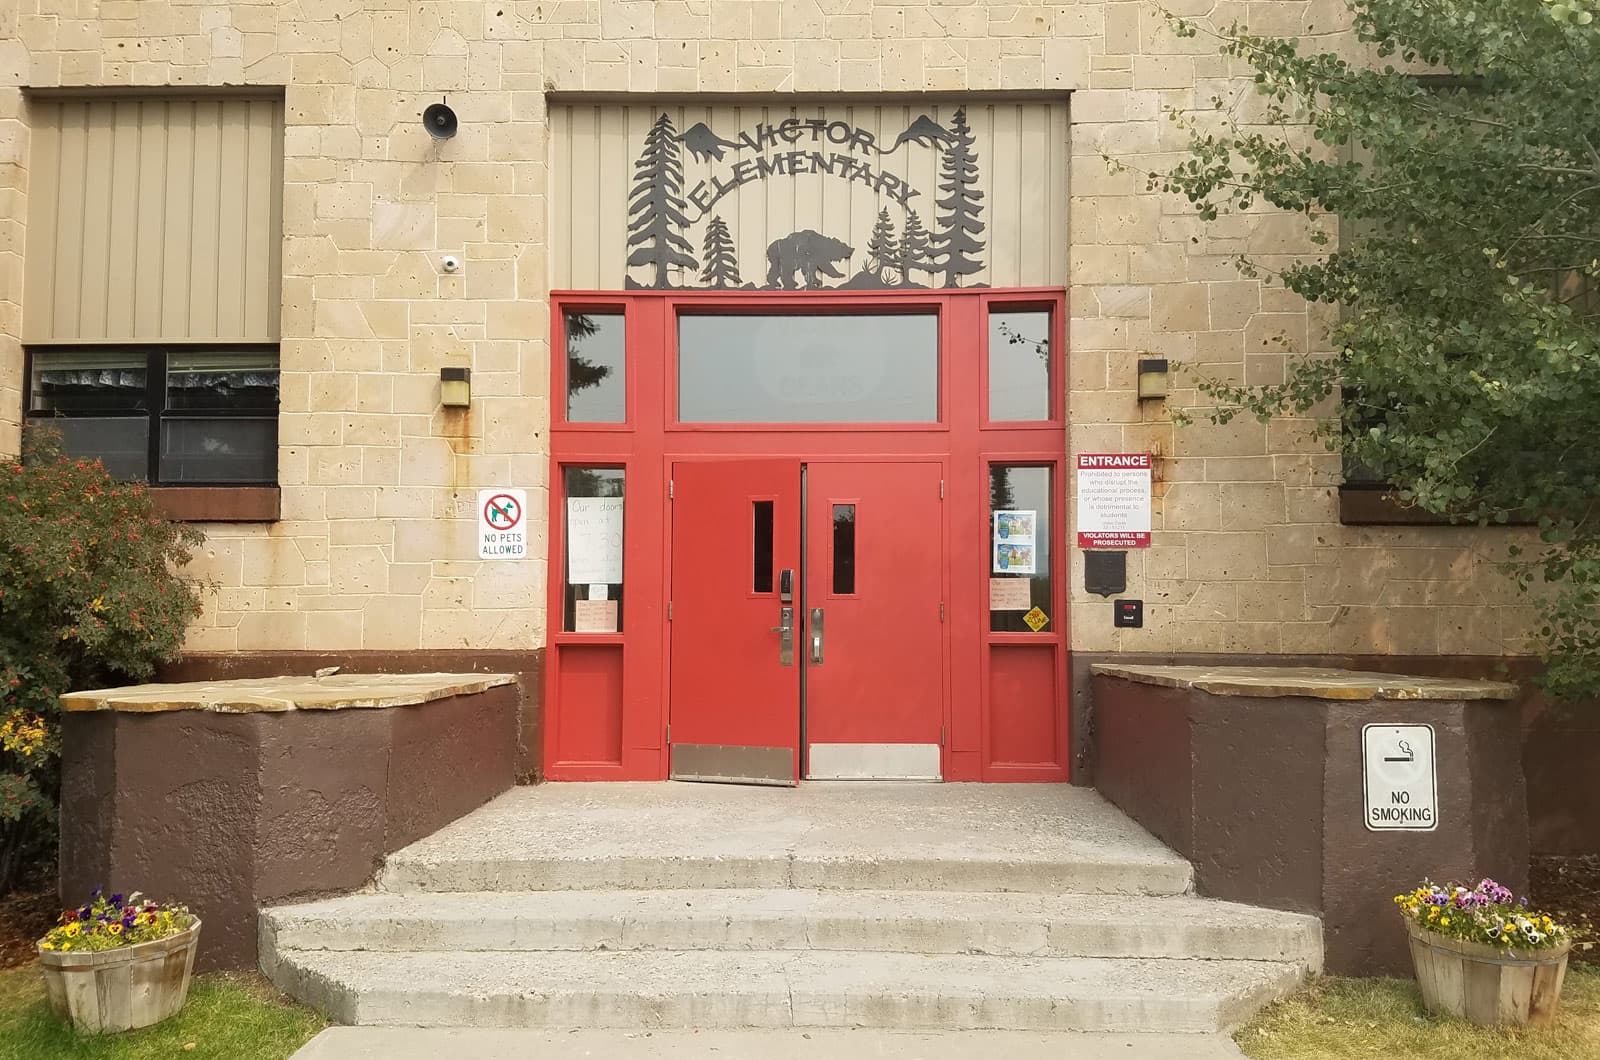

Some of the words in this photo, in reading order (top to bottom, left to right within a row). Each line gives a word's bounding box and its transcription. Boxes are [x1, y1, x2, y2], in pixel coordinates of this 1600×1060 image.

[739, 118, 876, 155] VICTOR
[687, 150, 921, 213] ELEMENTARY
[1080, 456, 1148, 466] ENTRANCE
[573, 499, 590, 512] Our
[600, 498, 622, 512] doors
[484, 534, 497, 543] NO
[500, 533, 522, 542] PETS
[482, 545, 523, 554] ALLOWED
[1391, 791, 1410, 804] NO
[1372, 807, 1431, 821] SMOKING
